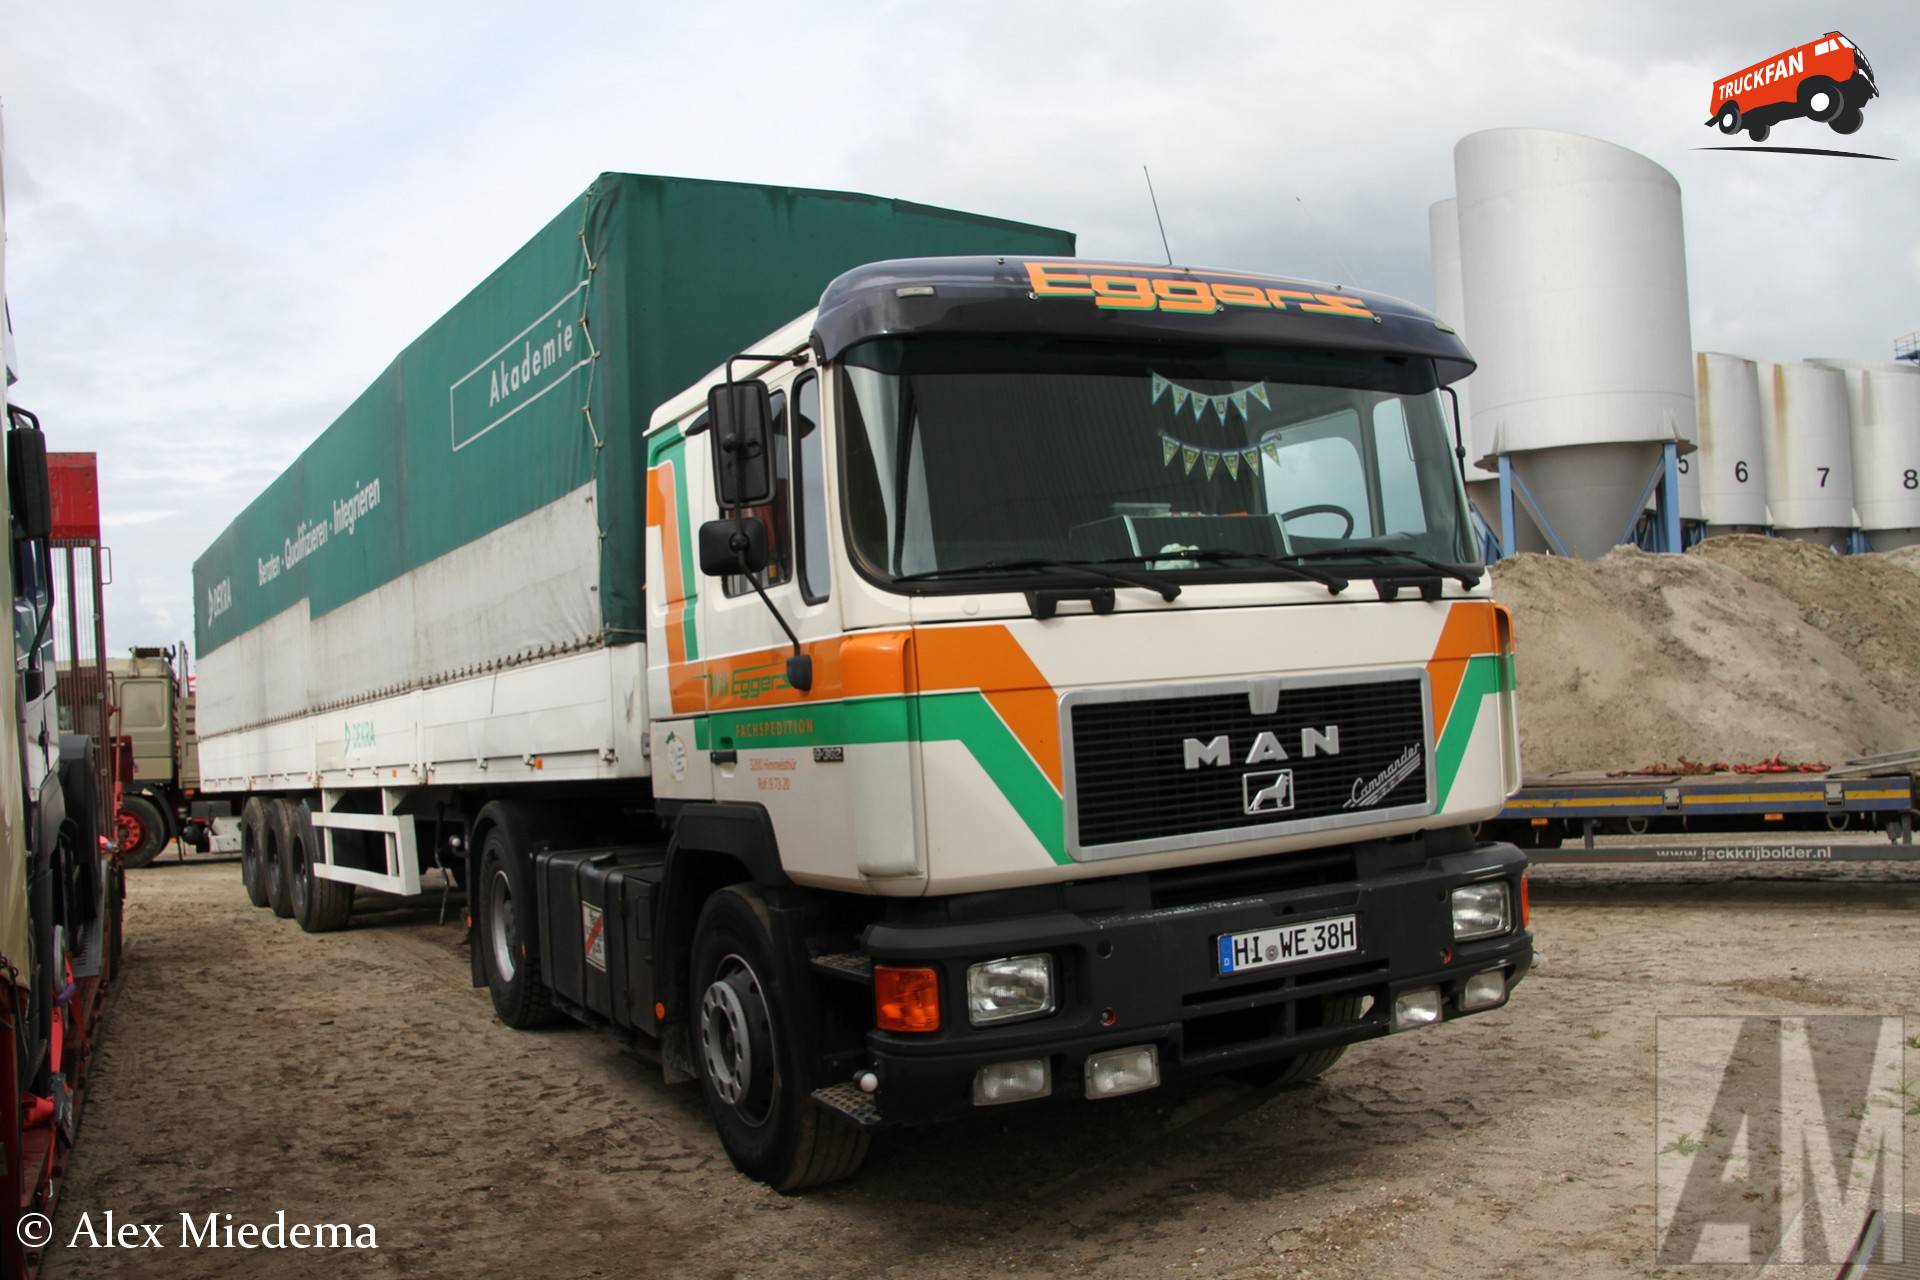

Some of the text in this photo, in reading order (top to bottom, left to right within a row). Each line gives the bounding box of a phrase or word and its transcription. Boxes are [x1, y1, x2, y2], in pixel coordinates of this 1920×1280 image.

[1024, 262, 1377, 314] Eggers
[489, 319, 573, 408] Akademie
[1678, 454, 1689, 474] 5
[1735, 461, 1748, 483] 6
[1817, 467, 1829, 488] 7
[1903, 469, 1919, 489] 8
[285, 520, 328, 570] Qualifizieren
[333, 478, 380, 535] Integrieren
[735, 719, 814, 738] FACHSPEDITION
[1183, 725, 1340, 770] MAN
[1350, 742, 1420, 804] Commander
[1233, 921, 1355, 966] HI WE 38H
[1223, 957, 1231, 966] D
